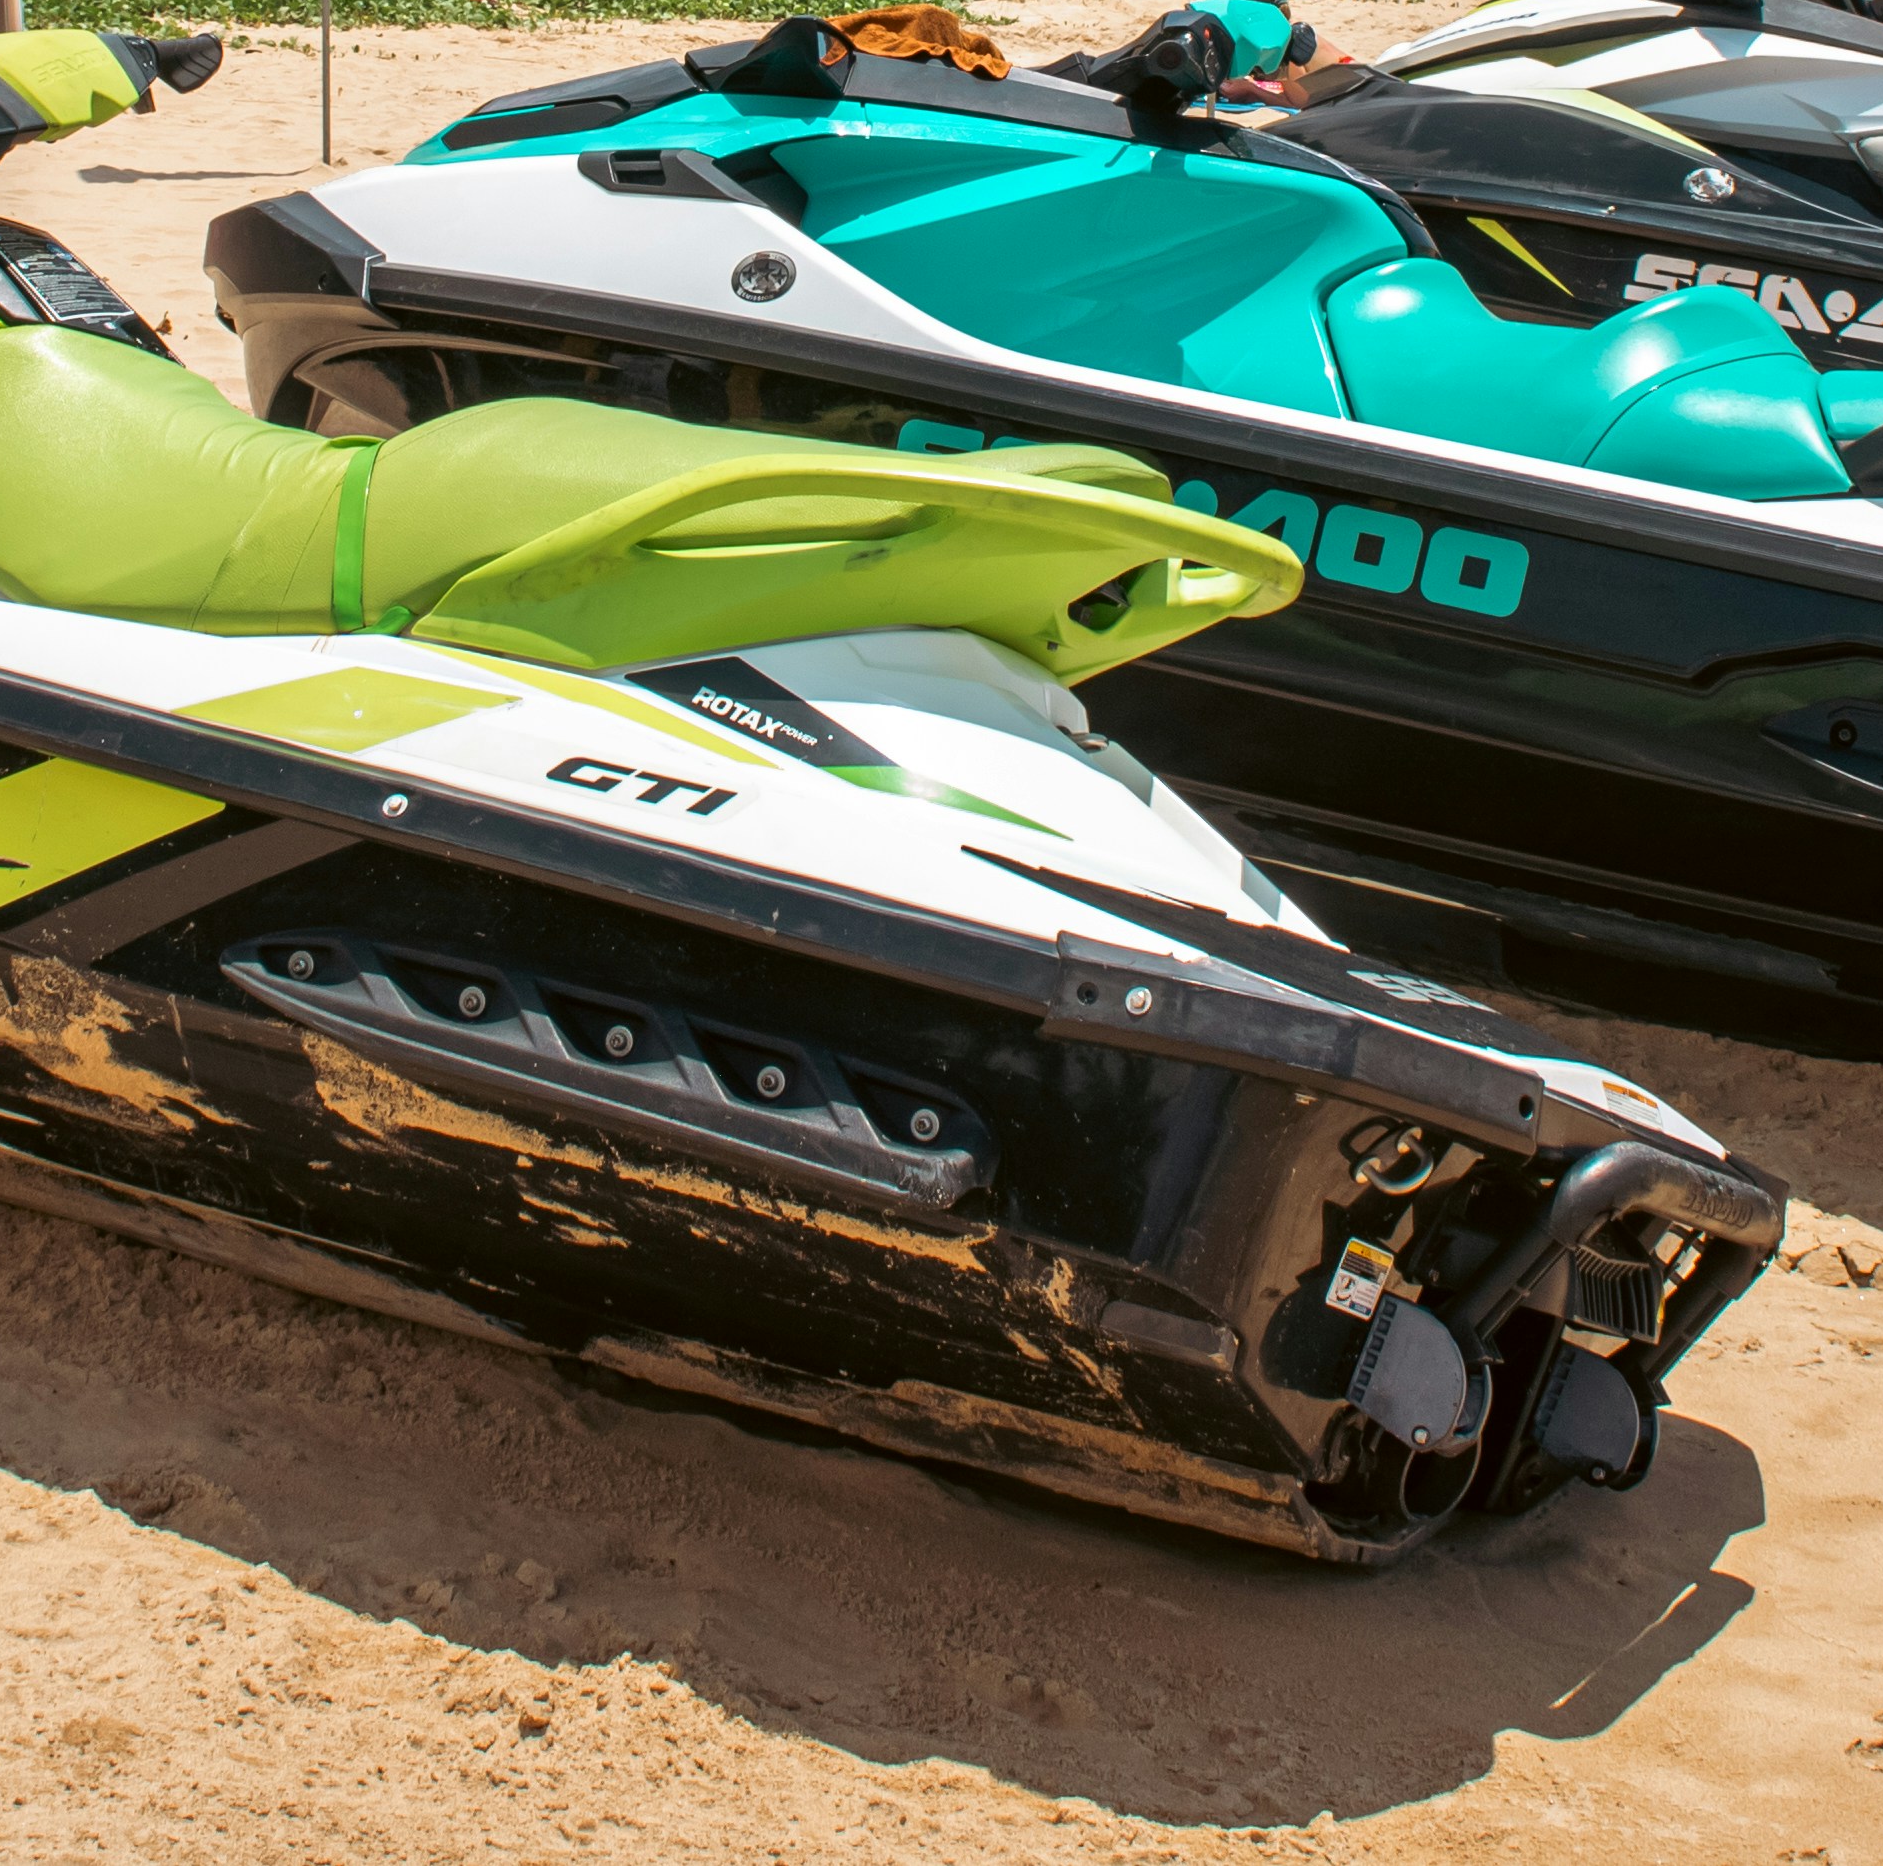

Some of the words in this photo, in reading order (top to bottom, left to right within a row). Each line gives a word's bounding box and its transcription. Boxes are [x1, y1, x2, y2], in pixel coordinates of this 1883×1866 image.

[691, 685, 785, 739] ROTAX
[779, 724, 818, 747] POWER
[546, 756, 738, 816] GTI
